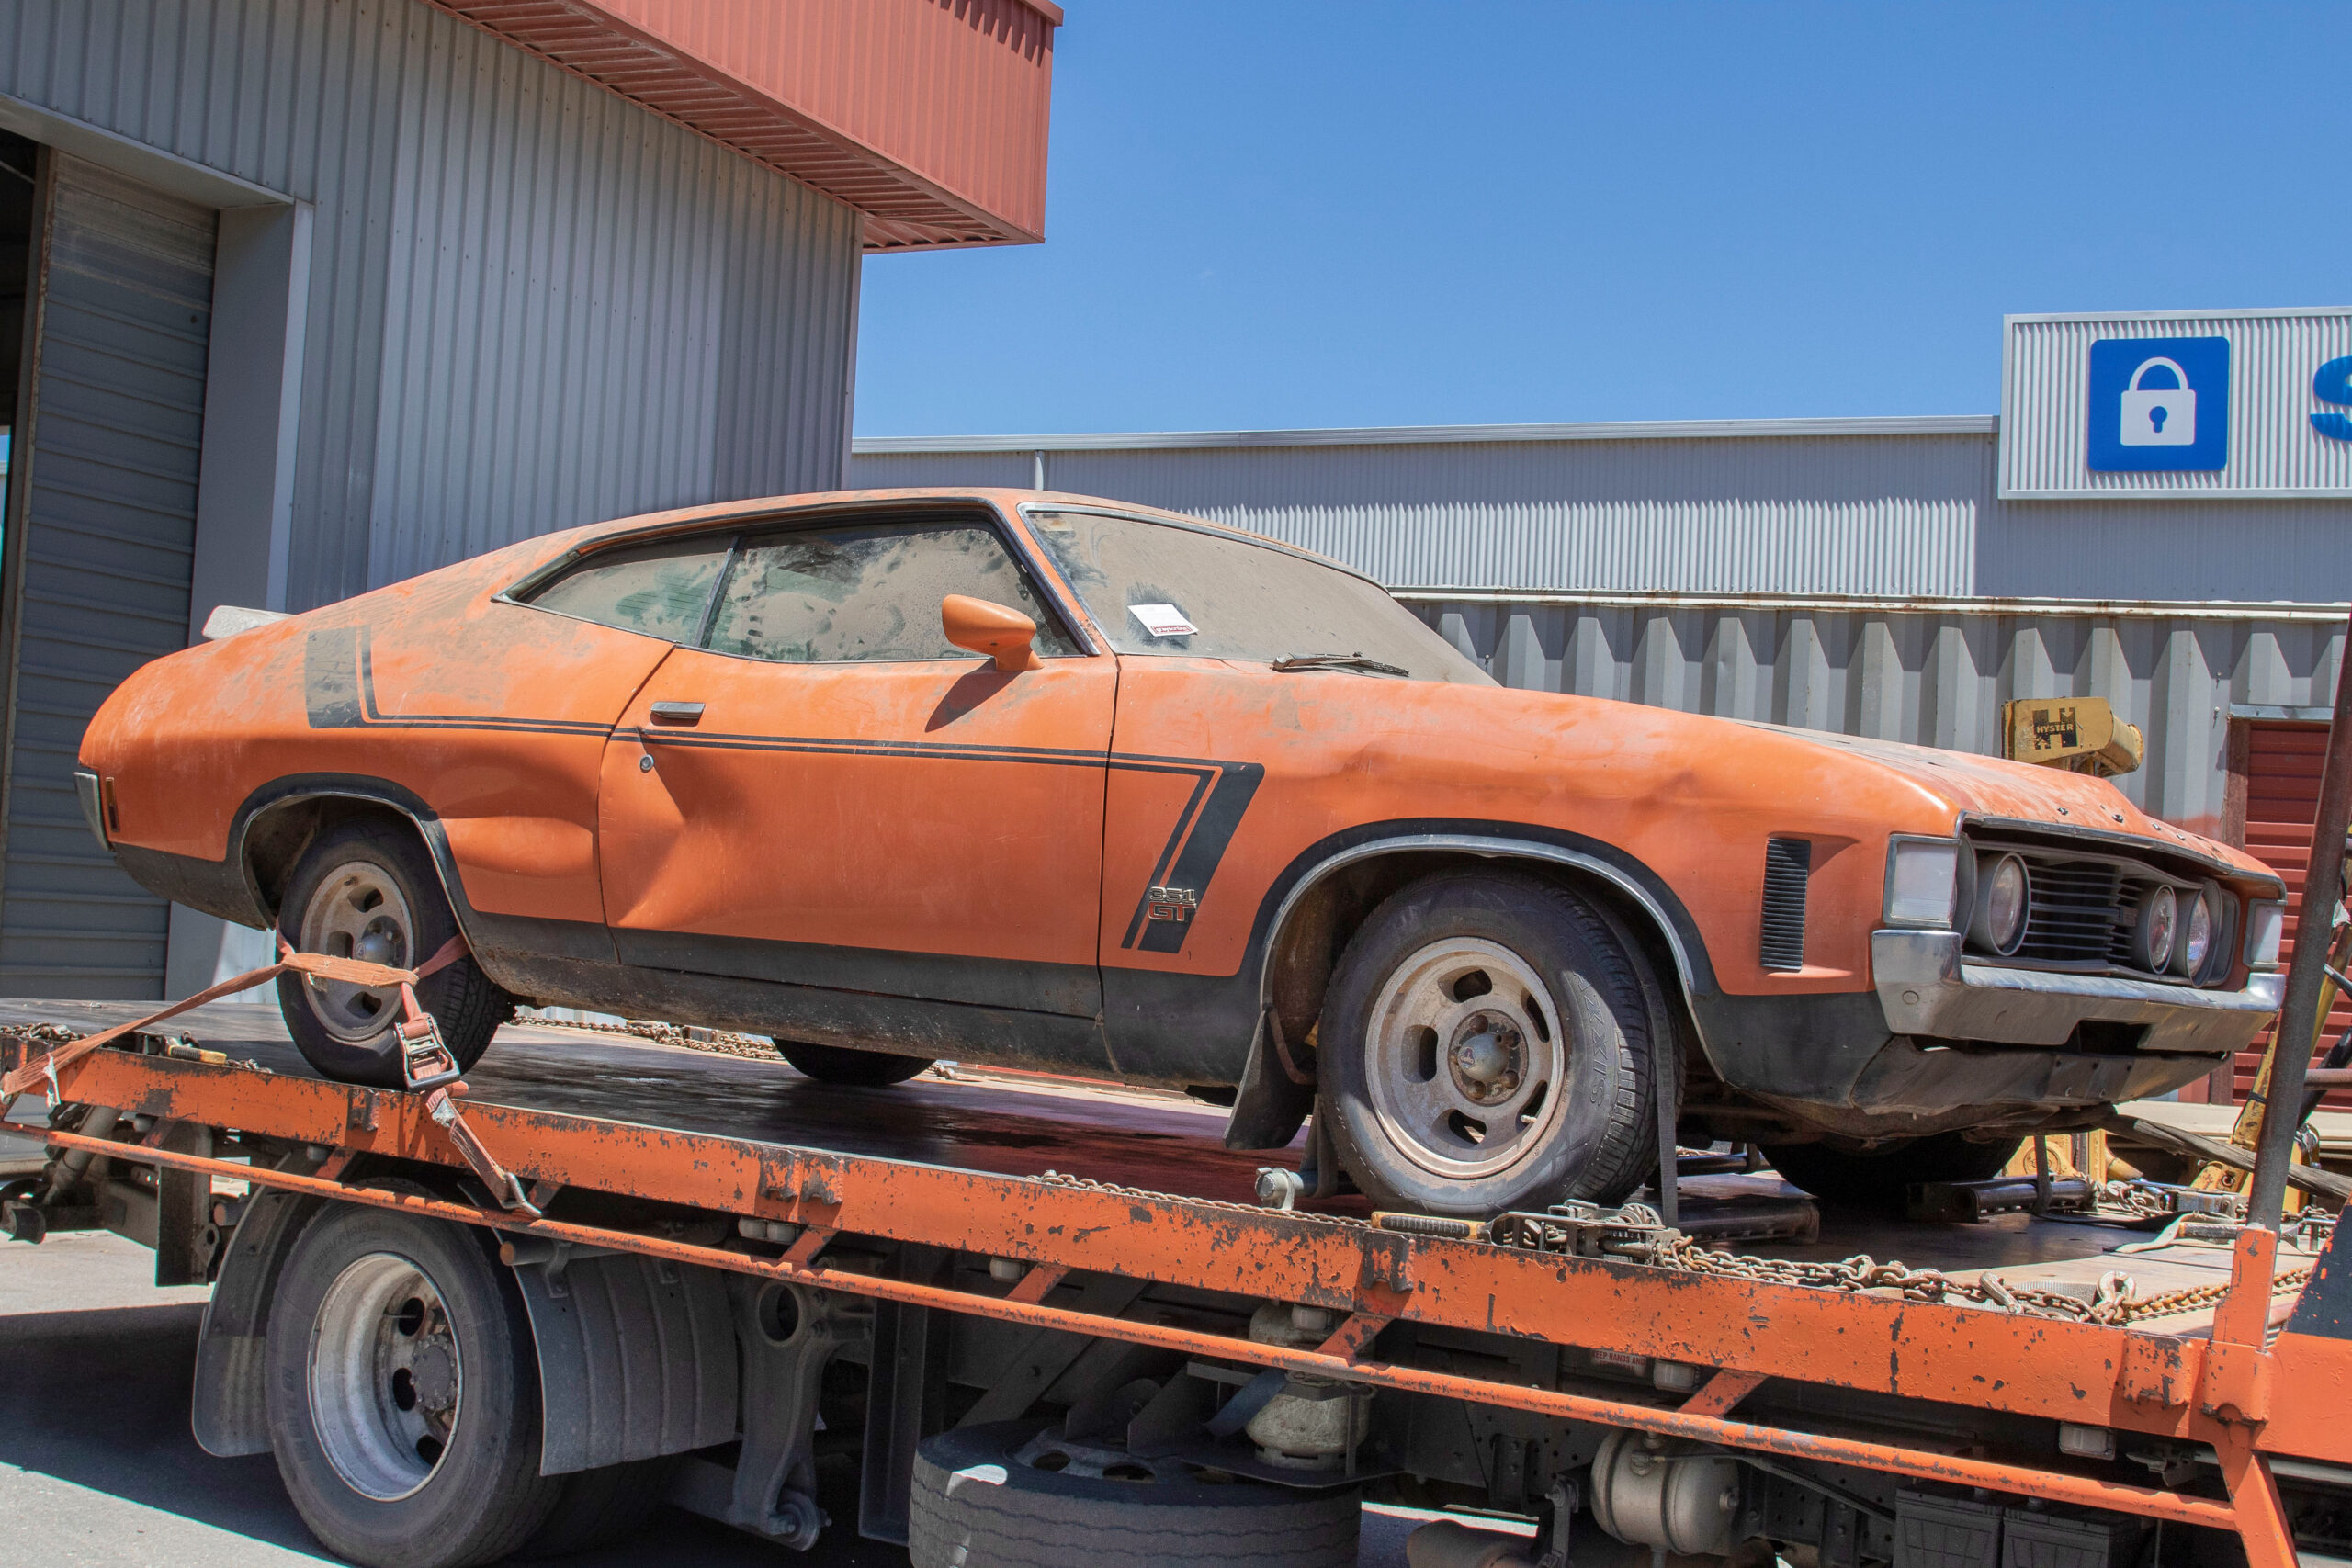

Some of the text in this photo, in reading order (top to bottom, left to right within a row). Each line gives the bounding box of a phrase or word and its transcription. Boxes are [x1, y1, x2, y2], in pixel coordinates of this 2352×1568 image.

[2036, 723, 2074, 733] HYSTER
[1149, 886, 1196, 904] 351
[1148, 900, 1197, 921] GT
[1567, 946, 1609, 1107] AXXIS
[1609, 1352, 1631, 1363] HANDS
[1632, 1356, 1645, 1366] AND
